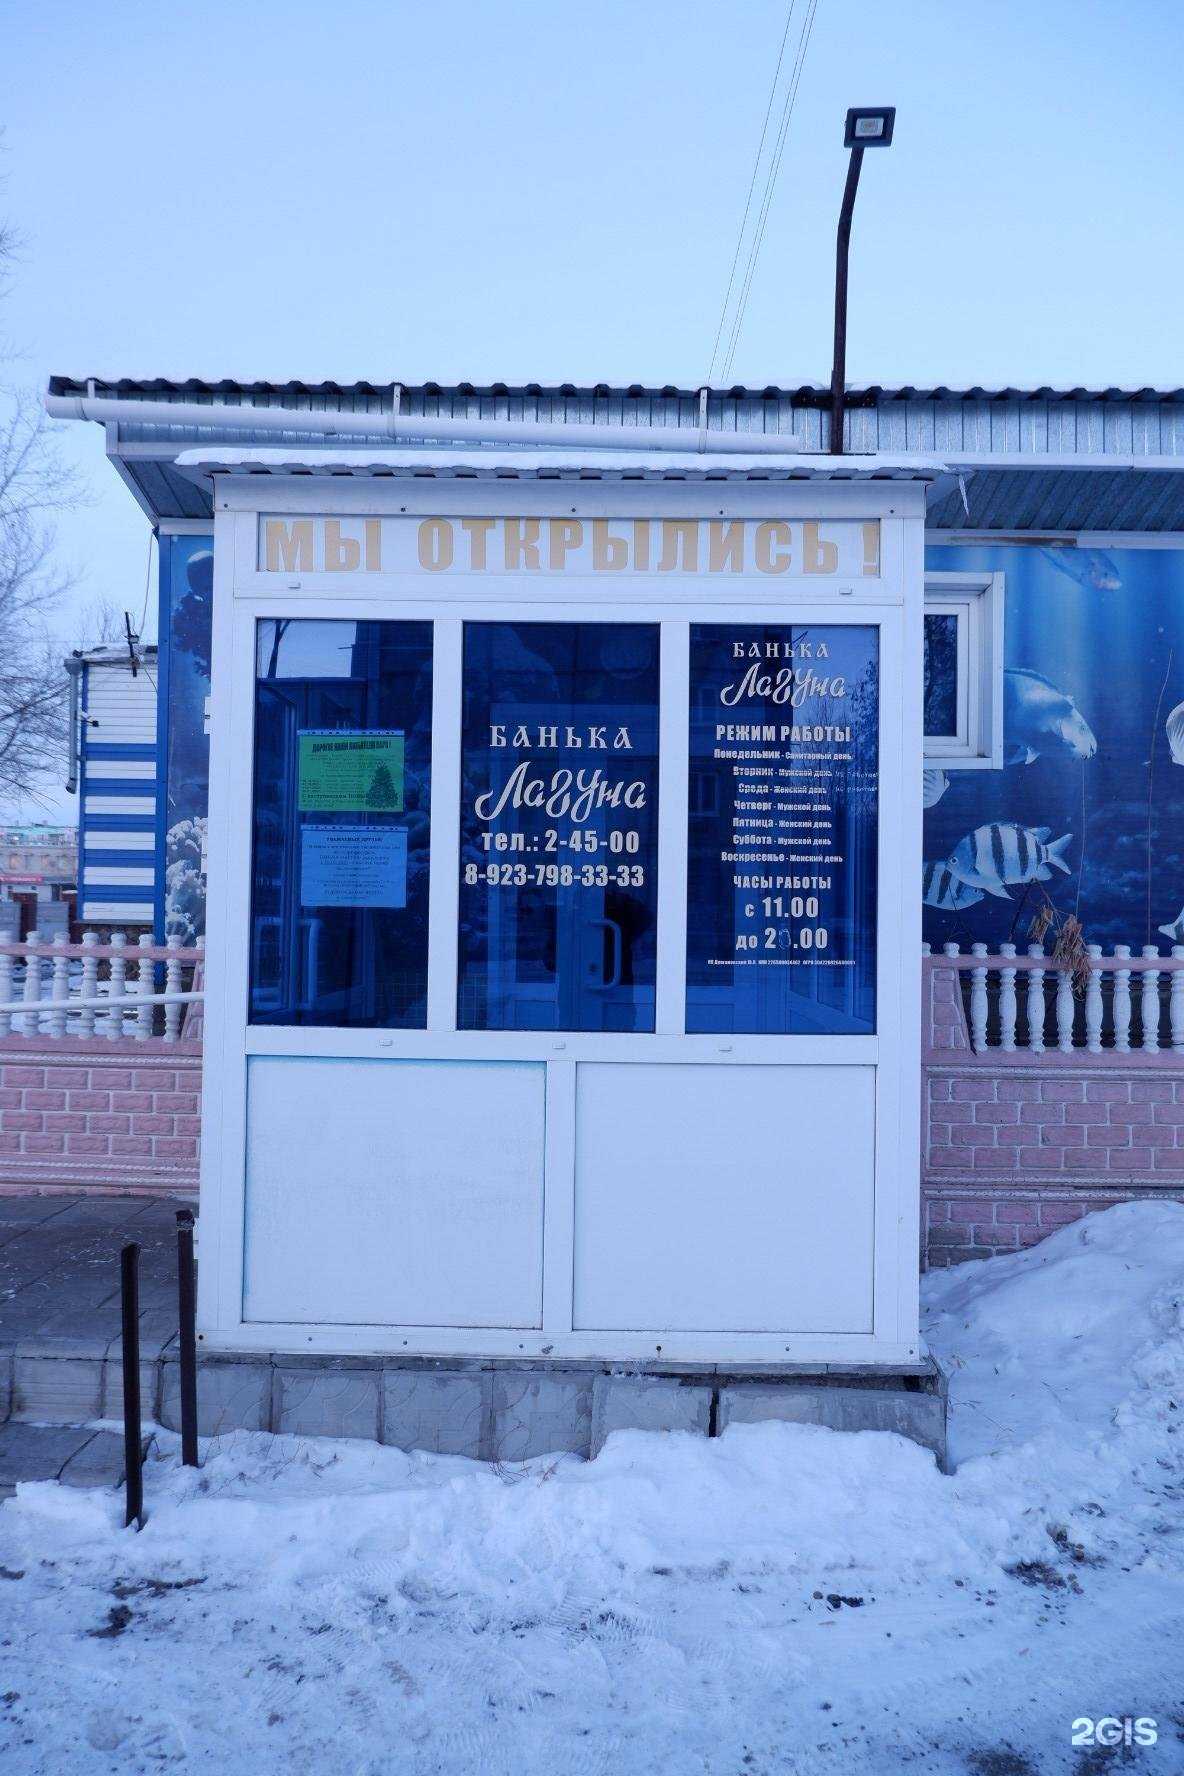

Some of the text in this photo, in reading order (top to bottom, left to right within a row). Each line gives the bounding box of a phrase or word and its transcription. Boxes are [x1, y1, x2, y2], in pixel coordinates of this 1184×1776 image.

[264, 519, 384, 573] МЫ
[733, 642, 829, 658] БАНЬКА
[720, 662, 846, 708] Лагуна
[489, 725, 633, 749] БАНЬКА
[716, 725, 851, 742] РЕЖИМ РАБОТЫ
[714, 749, 781, 759] Понедельник
[733, 766, 774, 776] Вторник
[474, 761, 647, 823] Лагуна
[738, 783, 769, 794] Среда
[774, 785, 807, 794] Женский
[734, 800, 773, 812] Четверг
[777, 802, 811, 812] Мужской
[812, 804, 831, 812] день
[732, 818, 774, 829] Пятница
[779, 820, 812, 829] Женский
[813, 821, 832, 829] день
[482, 829, 641, 854] тел.: 2-45-00
[733, 834, 773, 846] Суббота
[777, 837, 812, 846] Мужской
[812, 838, 832, 846] день
[721, 851, 785, 863] Воскресенье
[789, 854, 823, 863] Женский
[824, 855, 843, 864] день
[464, 863, 645, 888] 8-923-798-33-33
[733, 876, 832, 890] ЧАСЫ РАБОТЫ
[762, 896, 819, 918] 11.00
[735, 934, 758, 951] до
